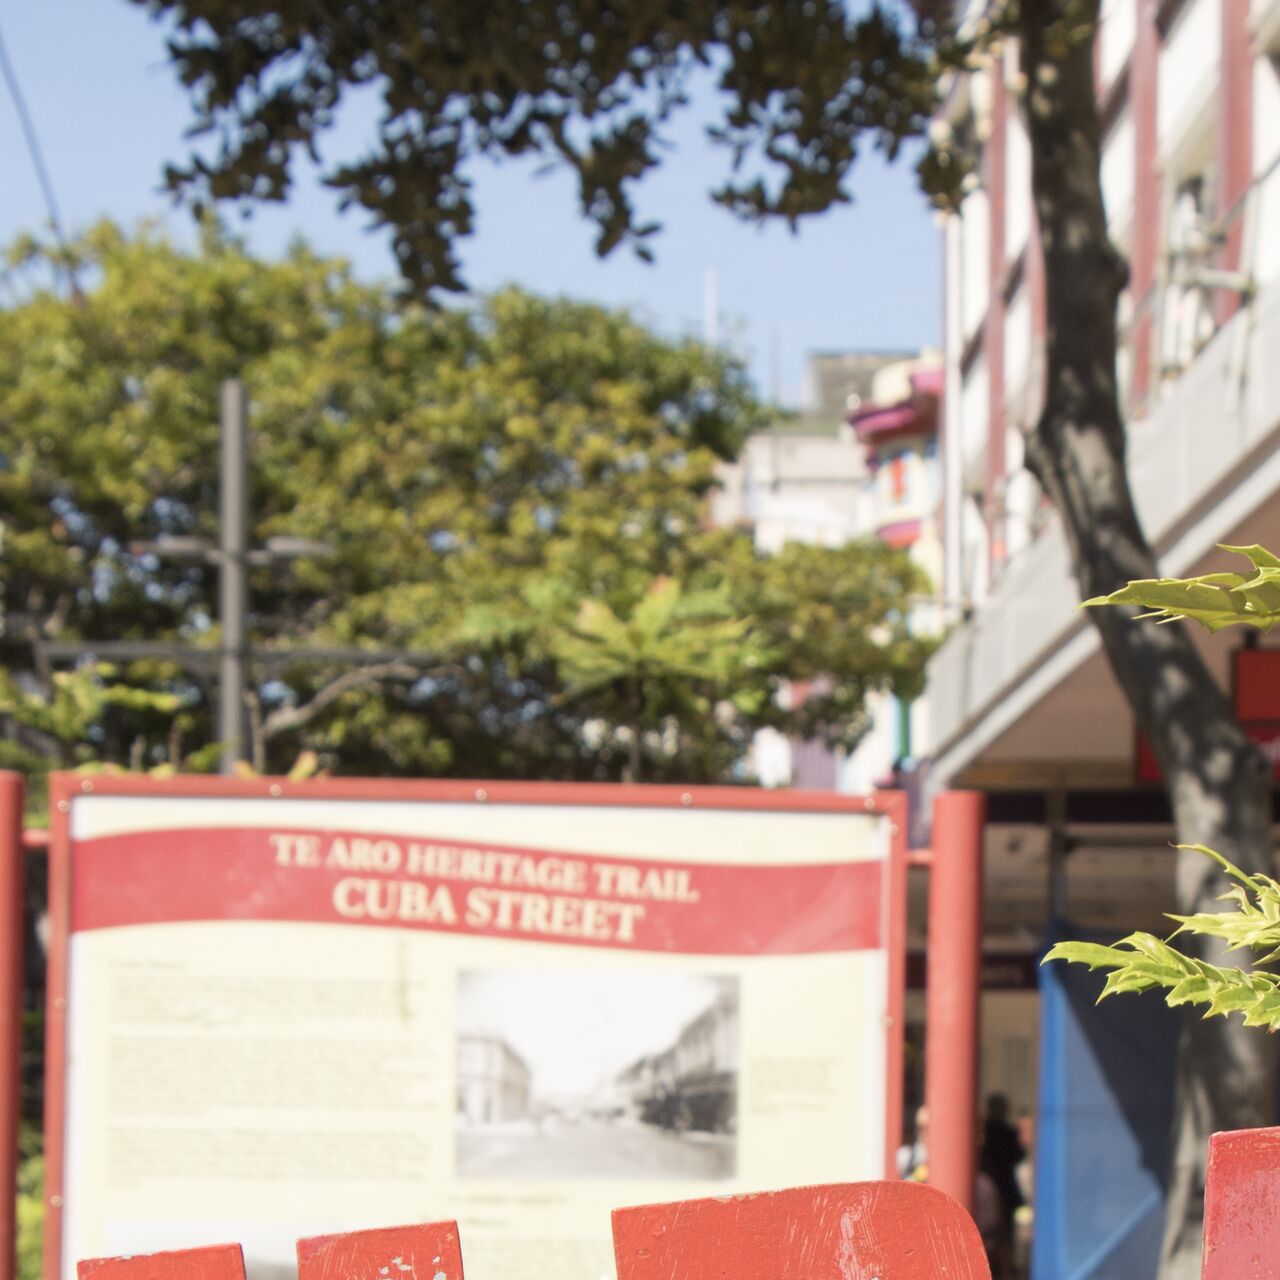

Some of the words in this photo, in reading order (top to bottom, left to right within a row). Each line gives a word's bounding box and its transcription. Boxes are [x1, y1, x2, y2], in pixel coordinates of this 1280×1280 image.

[269, 833, 321, 868] TE
[326, 837, 402, 873] ARO
[409, 845, 586, 892] HERITAGE
[592, 863, 700, 903] TRAIL
[332, 876, 458, 925] CUBA
[466, 888, 645, 941] STREET
